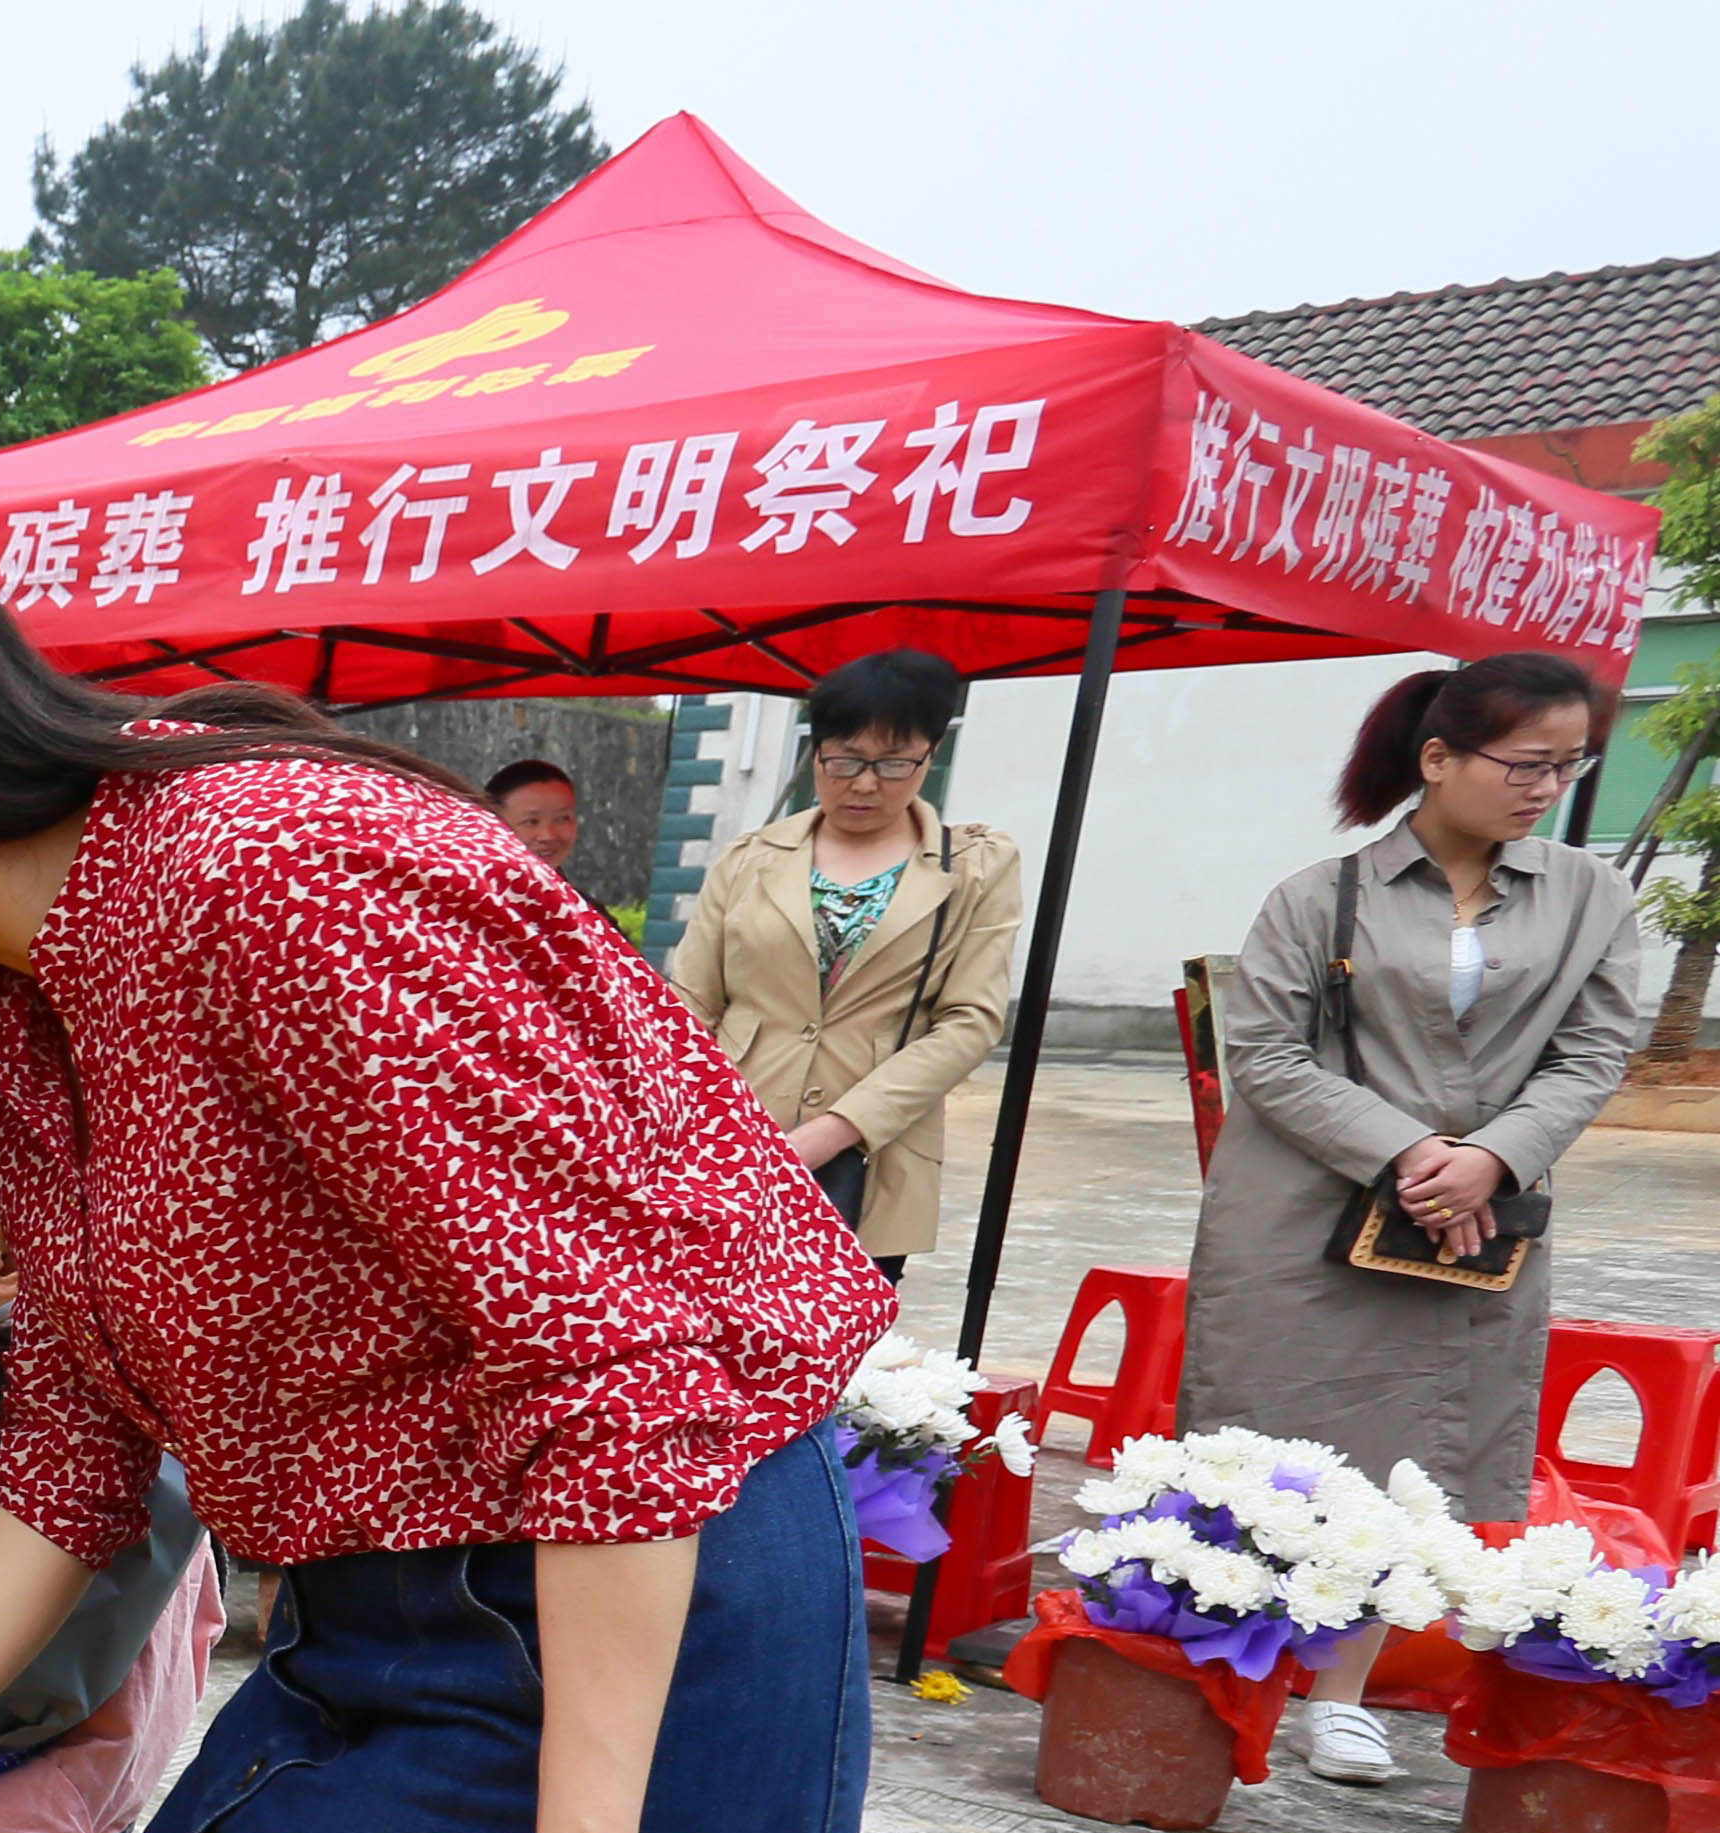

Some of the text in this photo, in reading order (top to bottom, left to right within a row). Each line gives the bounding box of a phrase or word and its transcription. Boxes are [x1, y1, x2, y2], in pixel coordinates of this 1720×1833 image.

[241, 398, 1048, 596] 推行文明祭祀
[1164, 390, 1648, 656] 推行文明殡葬 构建和谐社会
